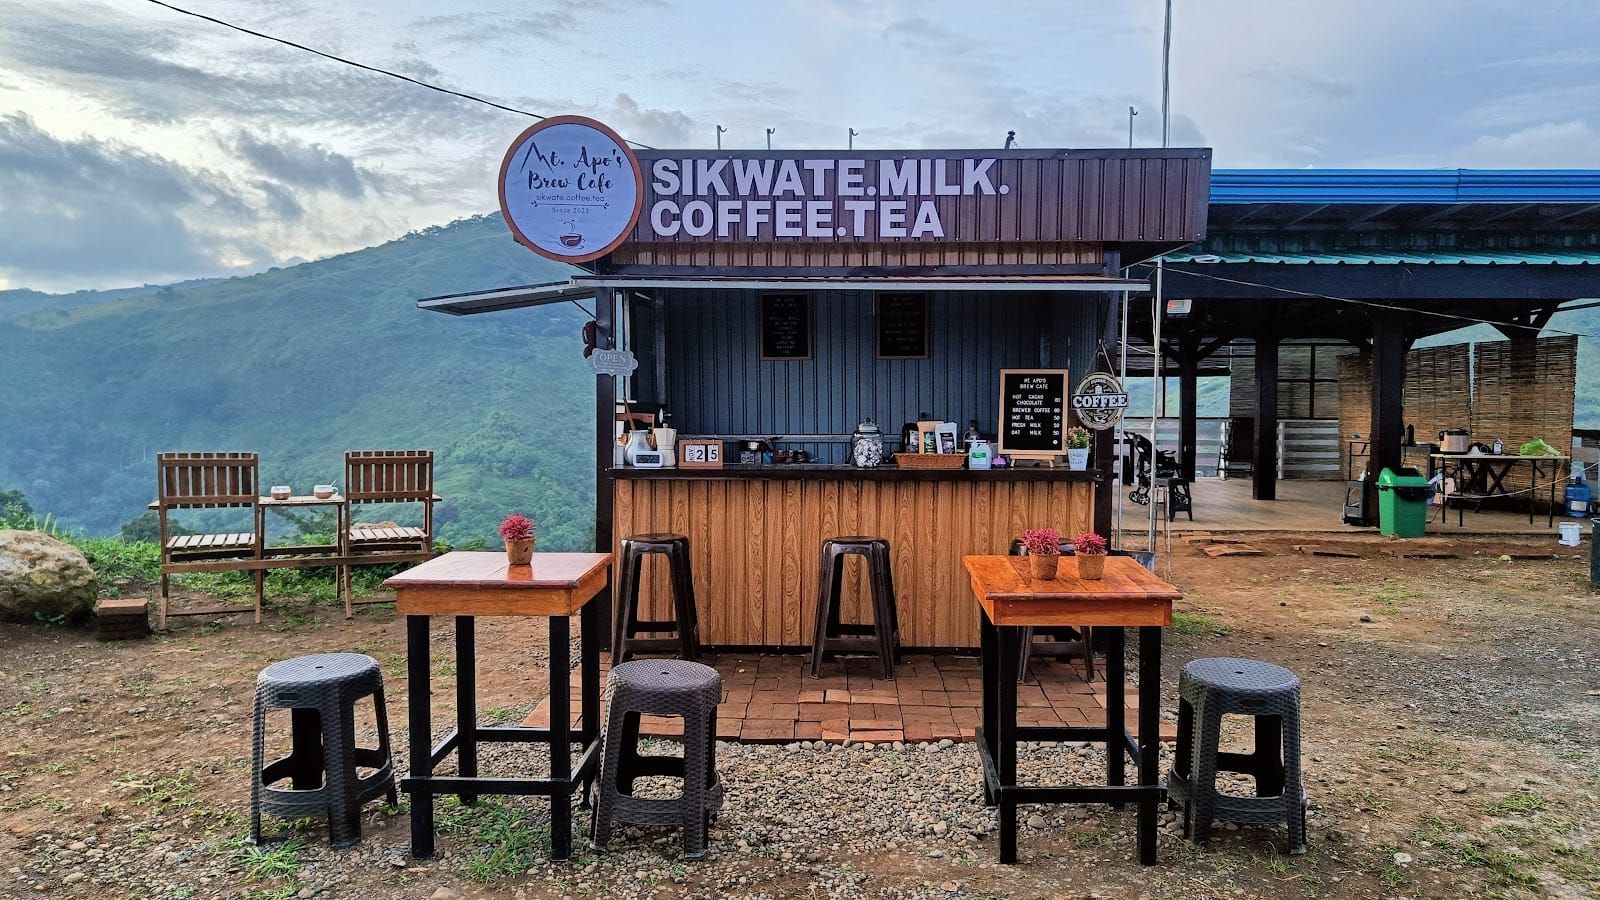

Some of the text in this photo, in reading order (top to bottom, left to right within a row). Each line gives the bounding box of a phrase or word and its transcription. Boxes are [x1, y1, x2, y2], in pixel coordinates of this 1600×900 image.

[520, 142, 624, 174] Mt. Apo's
[528, 170, 614, 193] Brew Cafe
[652, 159, 1010, 196] SIKWATE.MILK.
[537, 194, 605, 202] sikwate.coffee.tea
[651, 200, 944, 237] COFFEE.TEA
[600, 354, 626, 362] OPEN
[1072, 395, 1127, 407] COFFEE
[696, 450, 717, 460] 2 5
